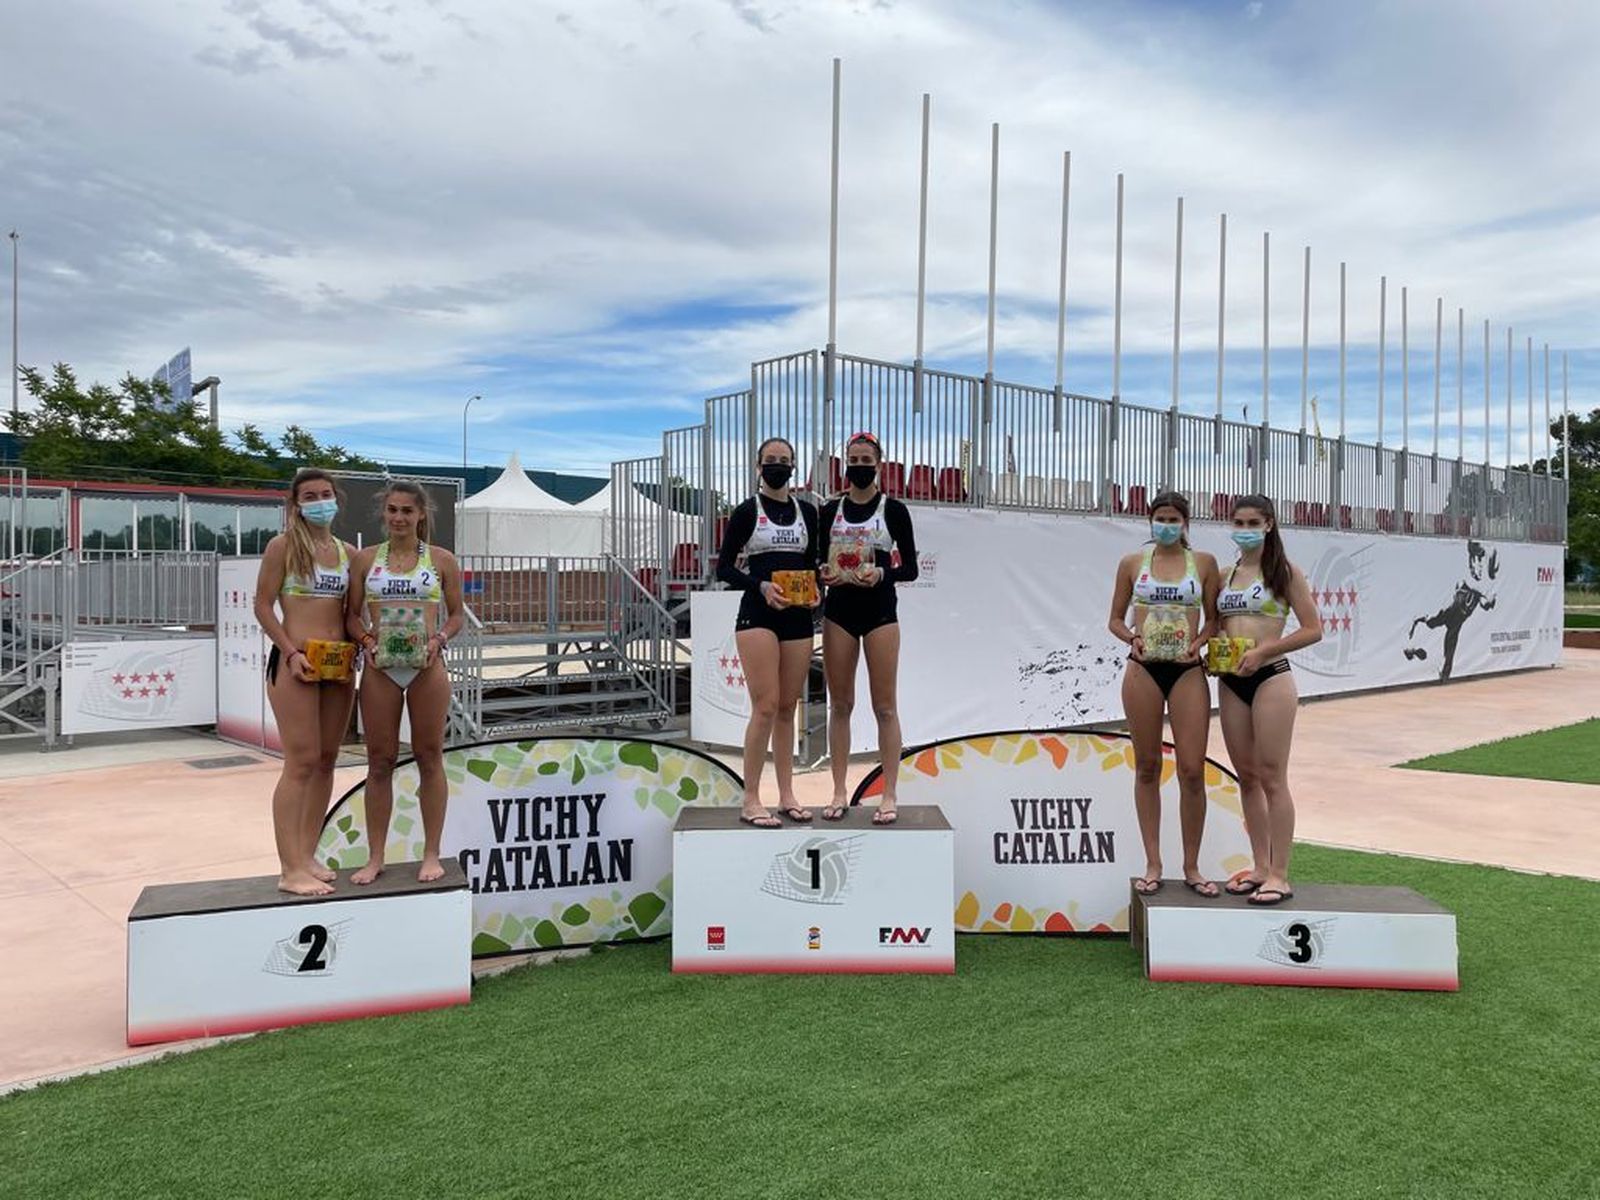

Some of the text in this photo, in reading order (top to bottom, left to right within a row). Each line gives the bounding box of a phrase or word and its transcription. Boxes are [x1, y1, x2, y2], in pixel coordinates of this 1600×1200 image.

[421, 571, 430, 587] 2
[1189, 580, 1195, 595] 1
[1252, 586, 1262, 600] 2
[487, 793, 606, 843] VICHY
[1011, 798, 1092, 830] VICHY
[993, 831, 1115, 864] CATALAN
[459, 839, 633, 894] CATALAN
[806, 849, 820, 889] 1
[298, 924, 328, 972] 2
[1288, 923, 1312, 963] 3
